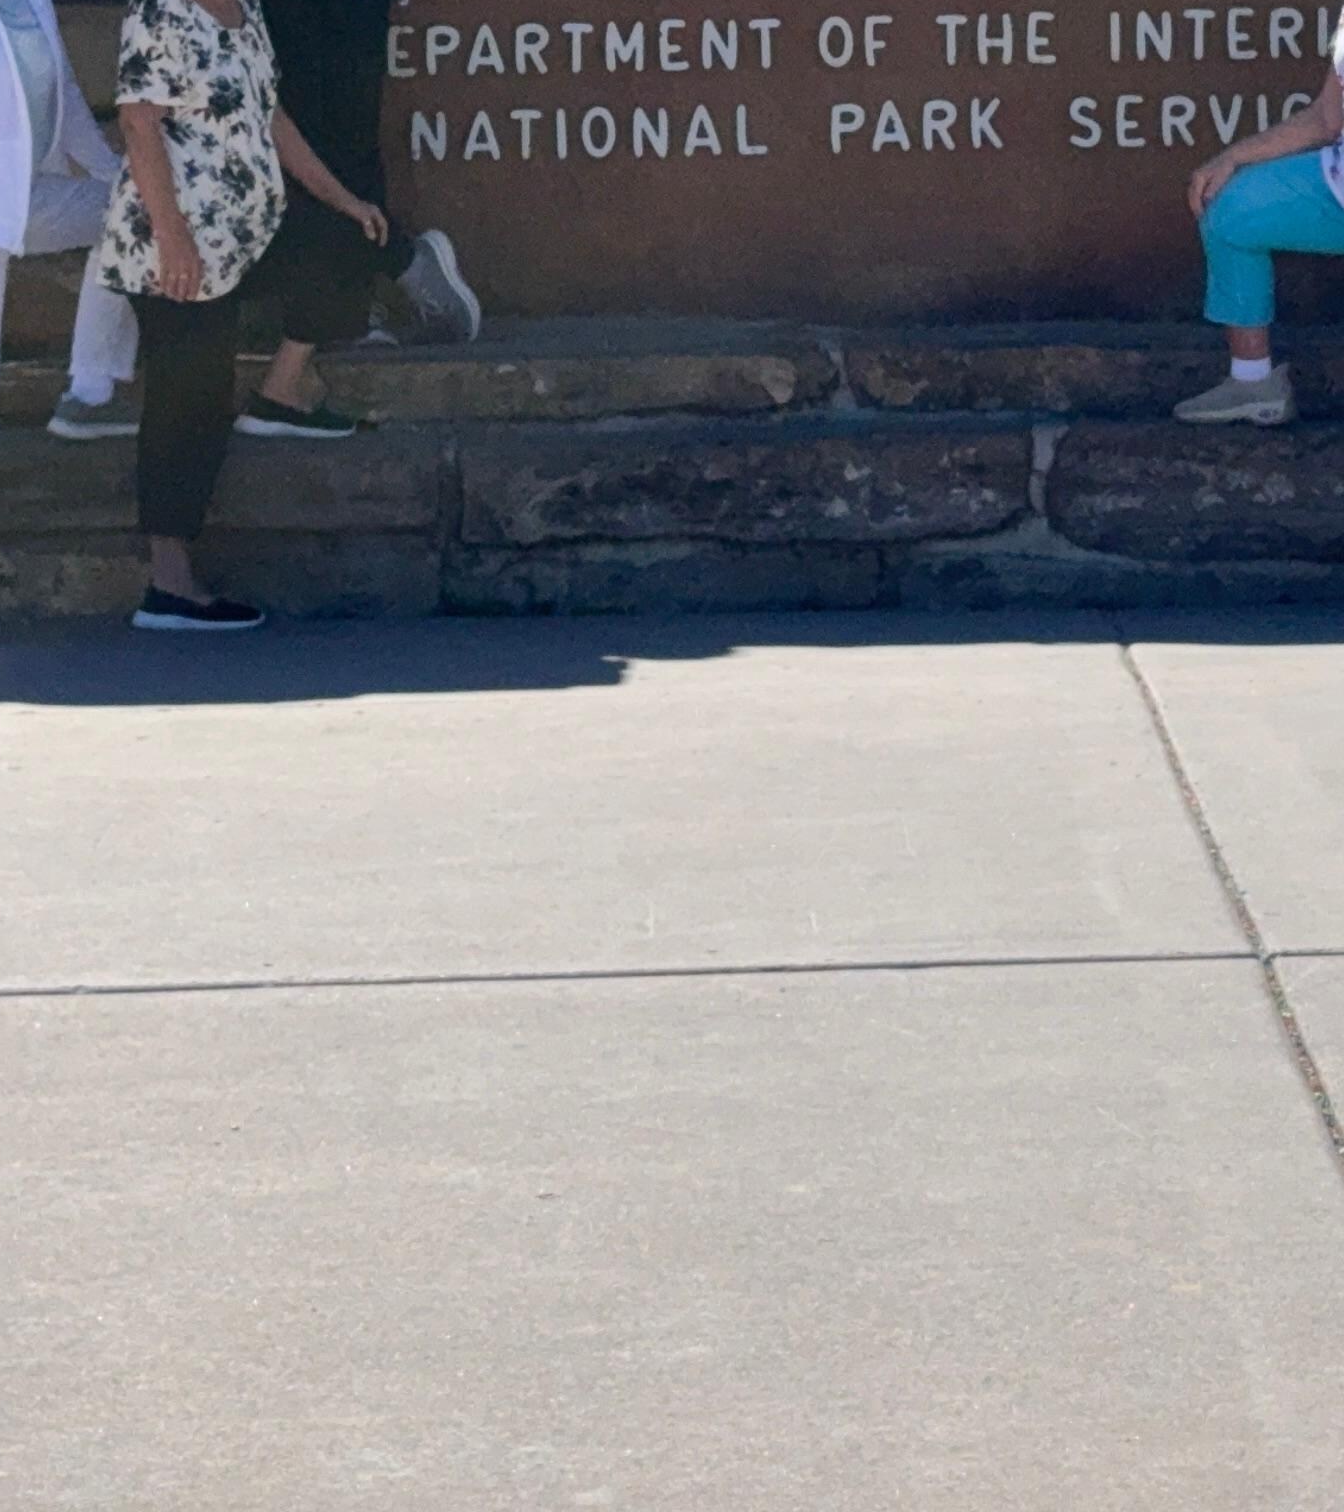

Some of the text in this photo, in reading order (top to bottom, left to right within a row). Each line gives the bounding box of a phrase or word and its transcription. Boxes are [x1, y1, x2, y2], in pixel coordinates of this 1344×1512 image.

[387, 6, 1329, 78] EPARTMENT OF THE INTERI
[411, 103, 769, 161] NATIONAL
[830, 96, 1004, 154] PARK
